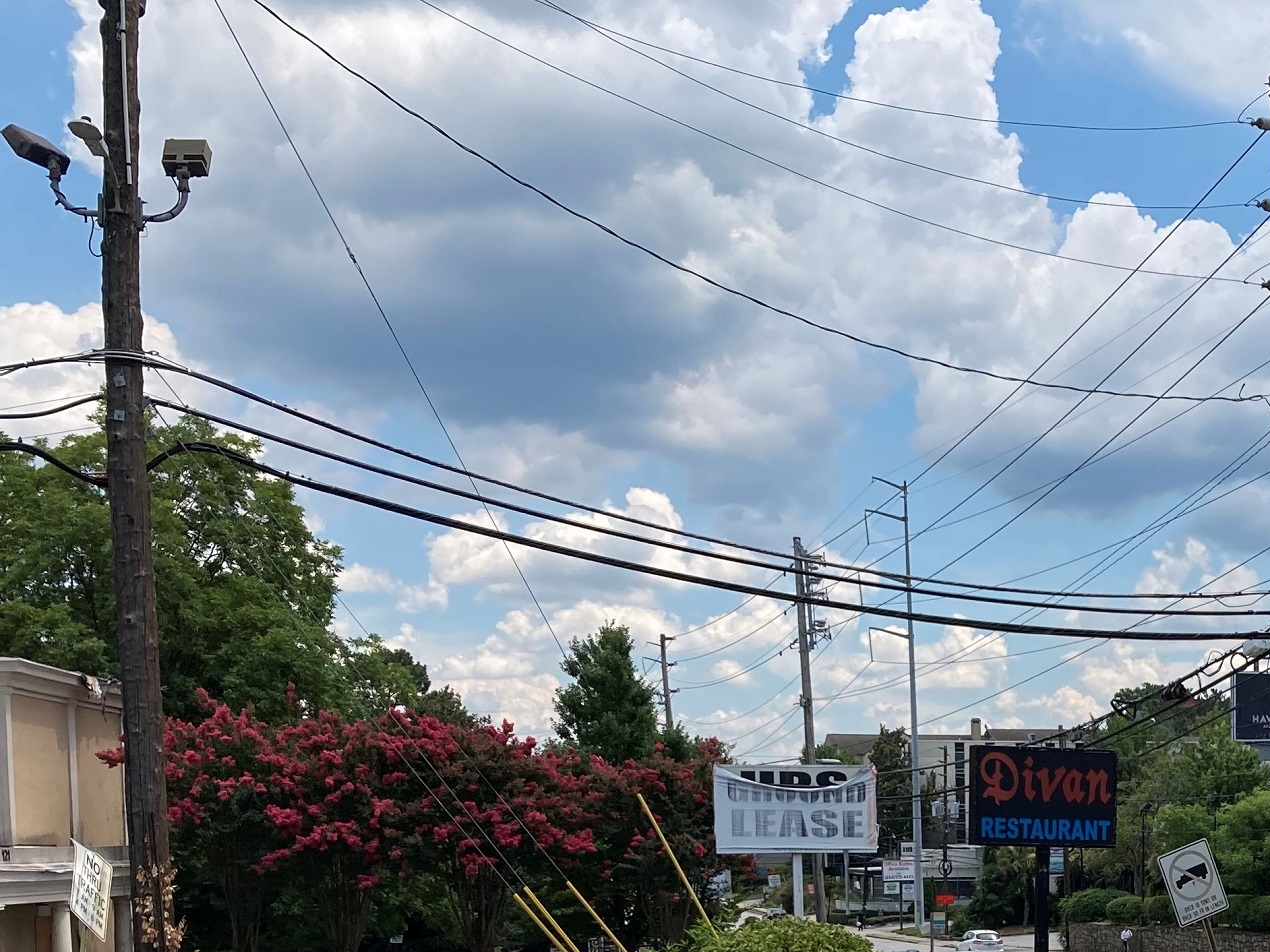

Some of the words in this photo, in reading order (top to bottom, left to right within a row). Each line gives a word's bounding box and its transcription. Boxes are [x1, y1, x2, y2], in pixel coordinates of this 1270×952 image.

[980, 751, 1112, 806] Divan
[731, 809, 864, 838] LEASE
[981, 817, 1111, 841] RESTAURANT
[83, 864, 102, 892] THRU
[86, 853, 101, 875] NO
[77, 873, 106, 911] TRAFFIC
[1182, 914, 1192, 922] OVER
